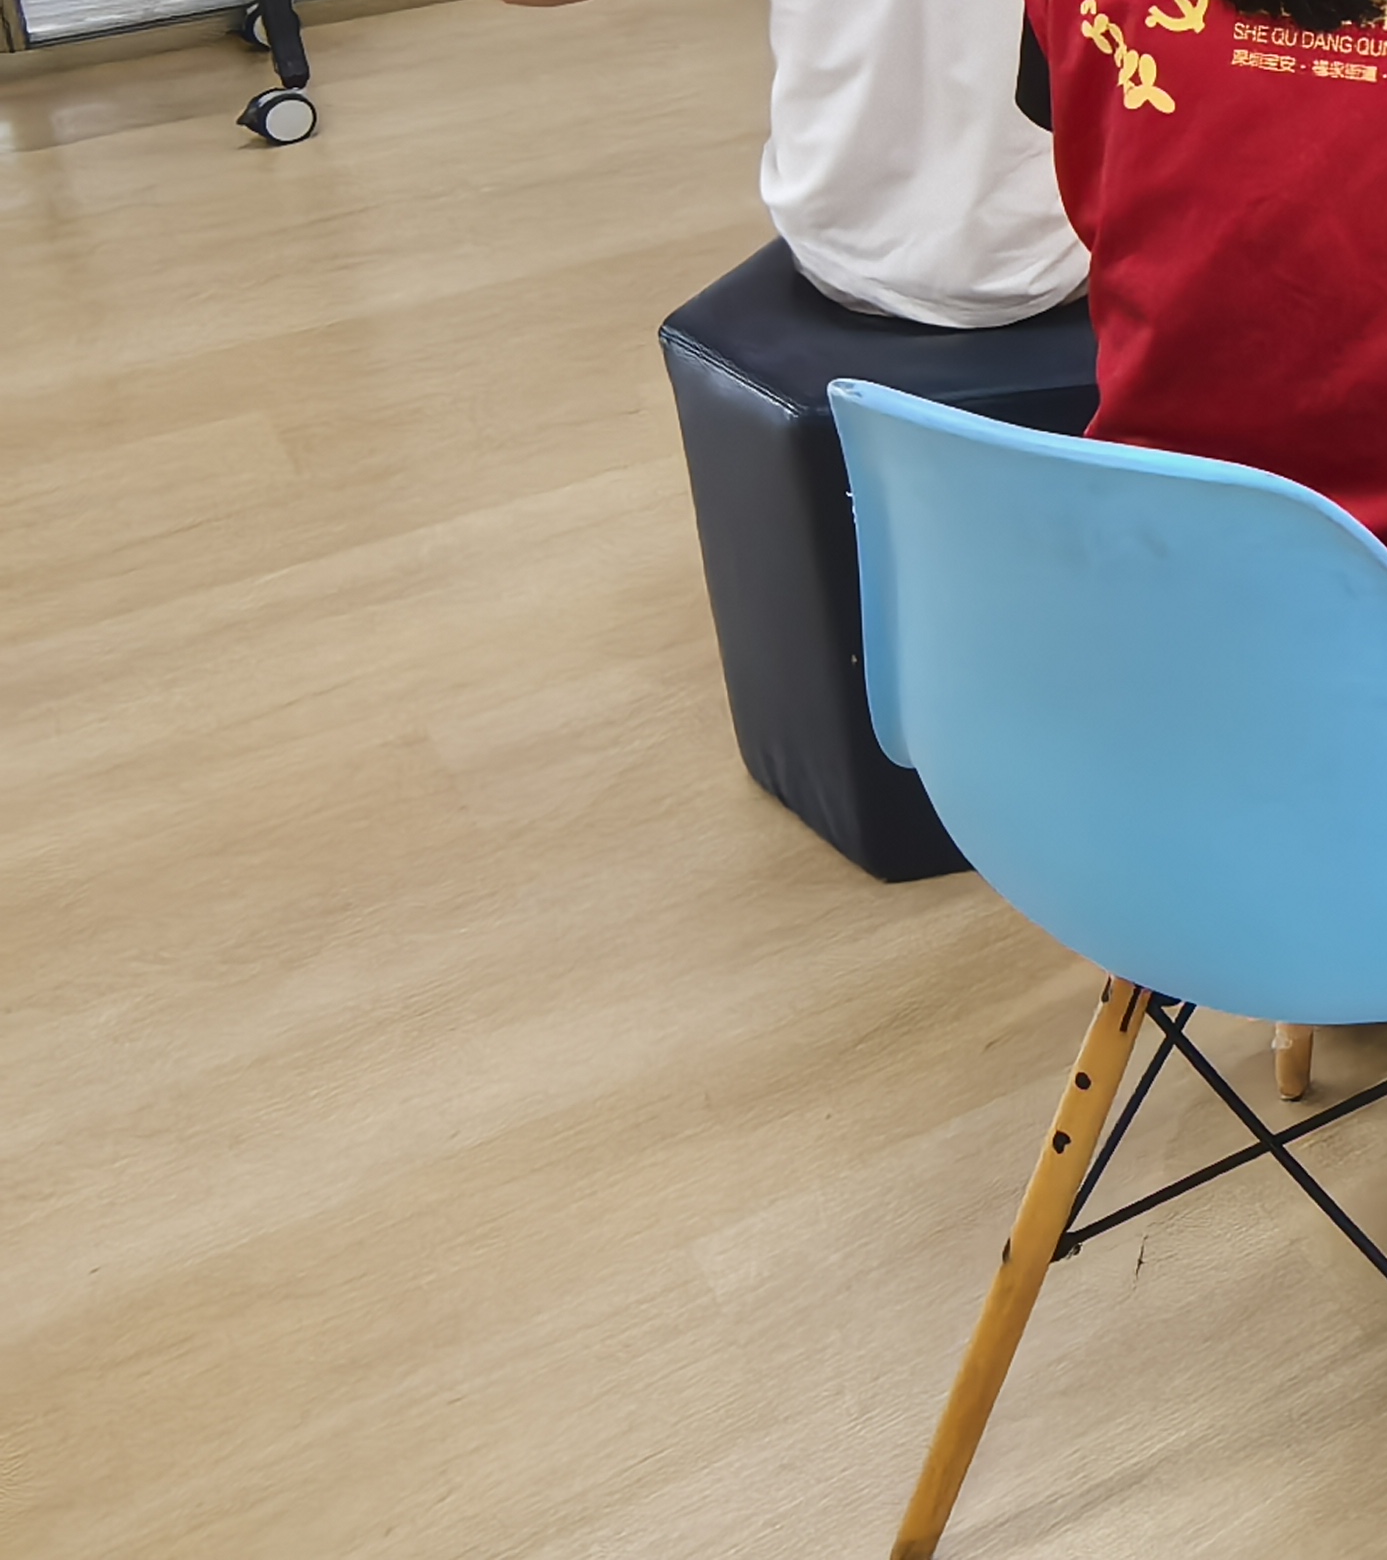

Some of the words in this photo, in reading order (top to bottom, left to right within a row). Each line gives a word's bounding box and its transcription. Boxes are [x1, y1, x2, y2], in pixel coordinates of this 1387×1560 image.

[1233, 22, 1270, 43] SHE
[1271, 26, 1298, 47] QU
[1301, 30, 1353, 54] DANG
